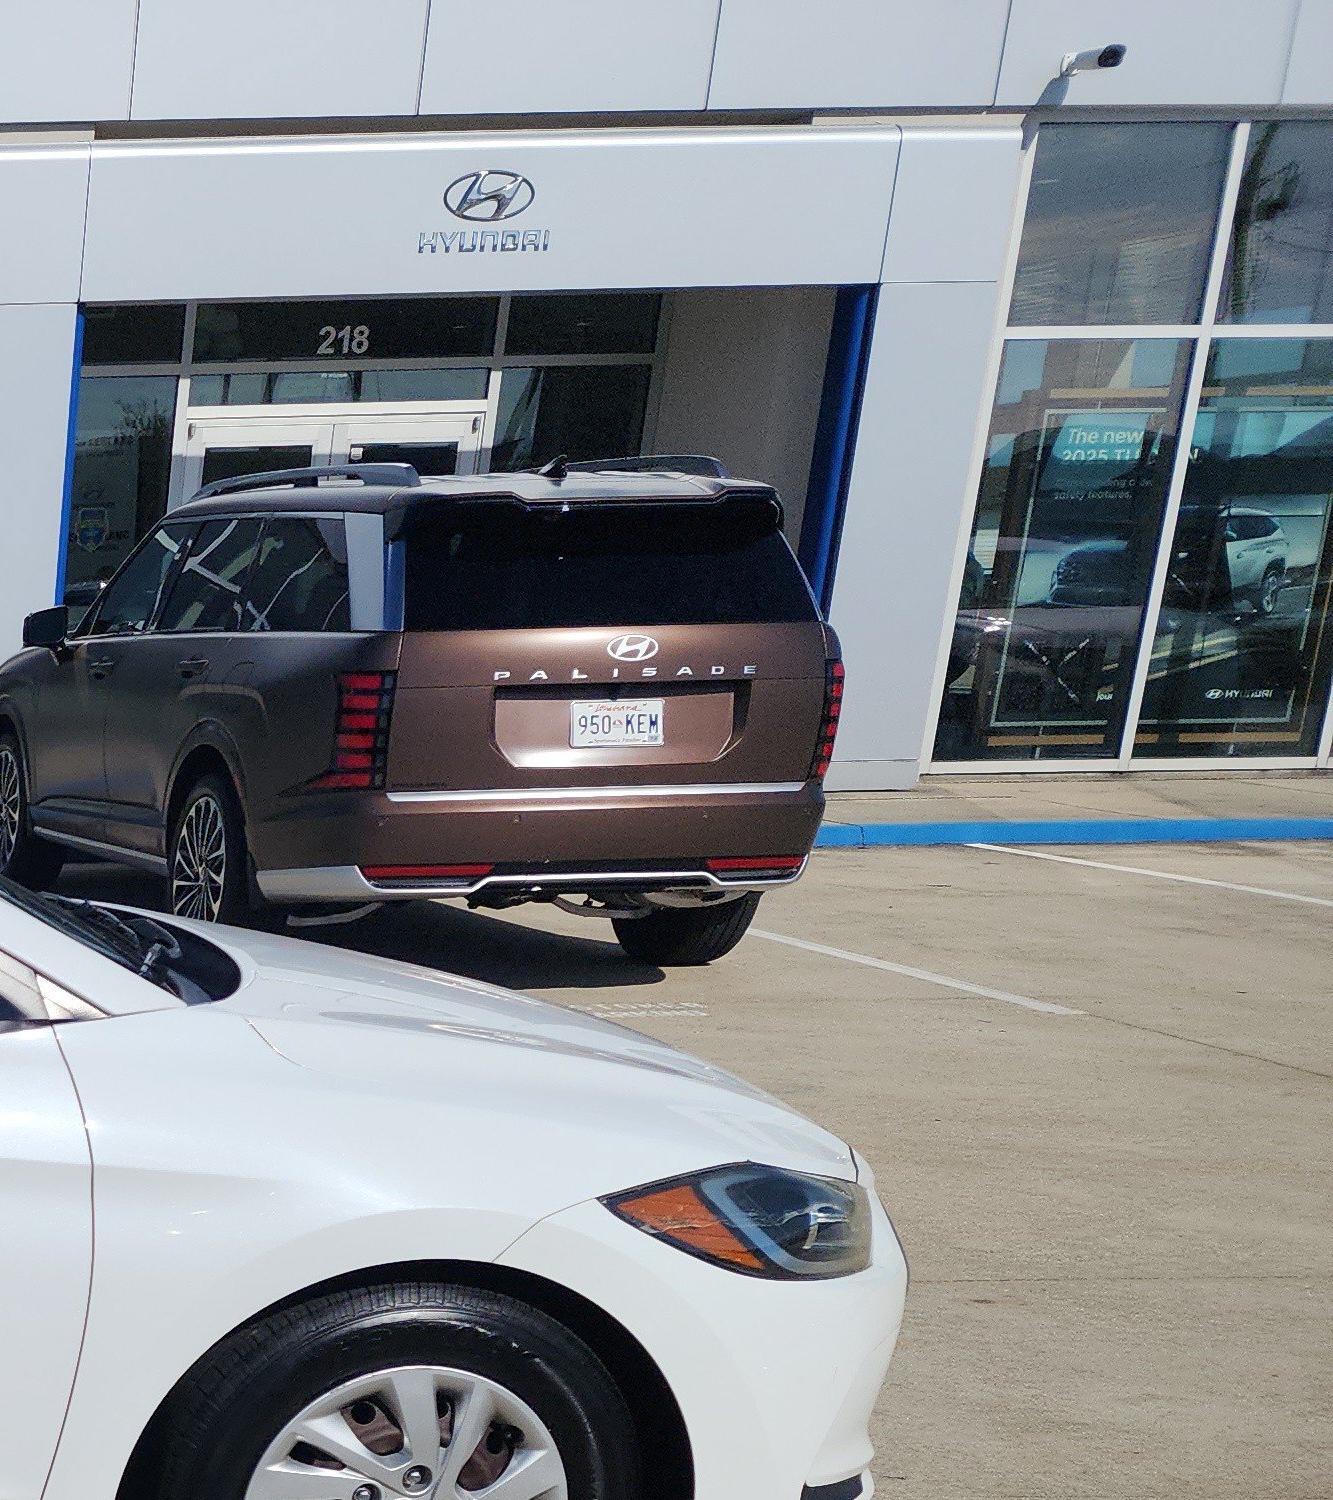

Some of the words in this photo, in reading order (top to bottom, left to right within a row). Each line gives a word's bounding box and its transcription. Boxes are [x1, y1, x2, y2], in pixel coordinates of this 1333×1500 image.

[418, 229, 550, 254] HYUNDAI
[316, 325, 370, 354] 218
[1067, 427, 1099, 445] The
[1102, 429, 1145, 445] new
[493, 664, 758, 681] PALISADE
[578, 714, 612, 736] 950
[624, 713, 659, 735] KEM
